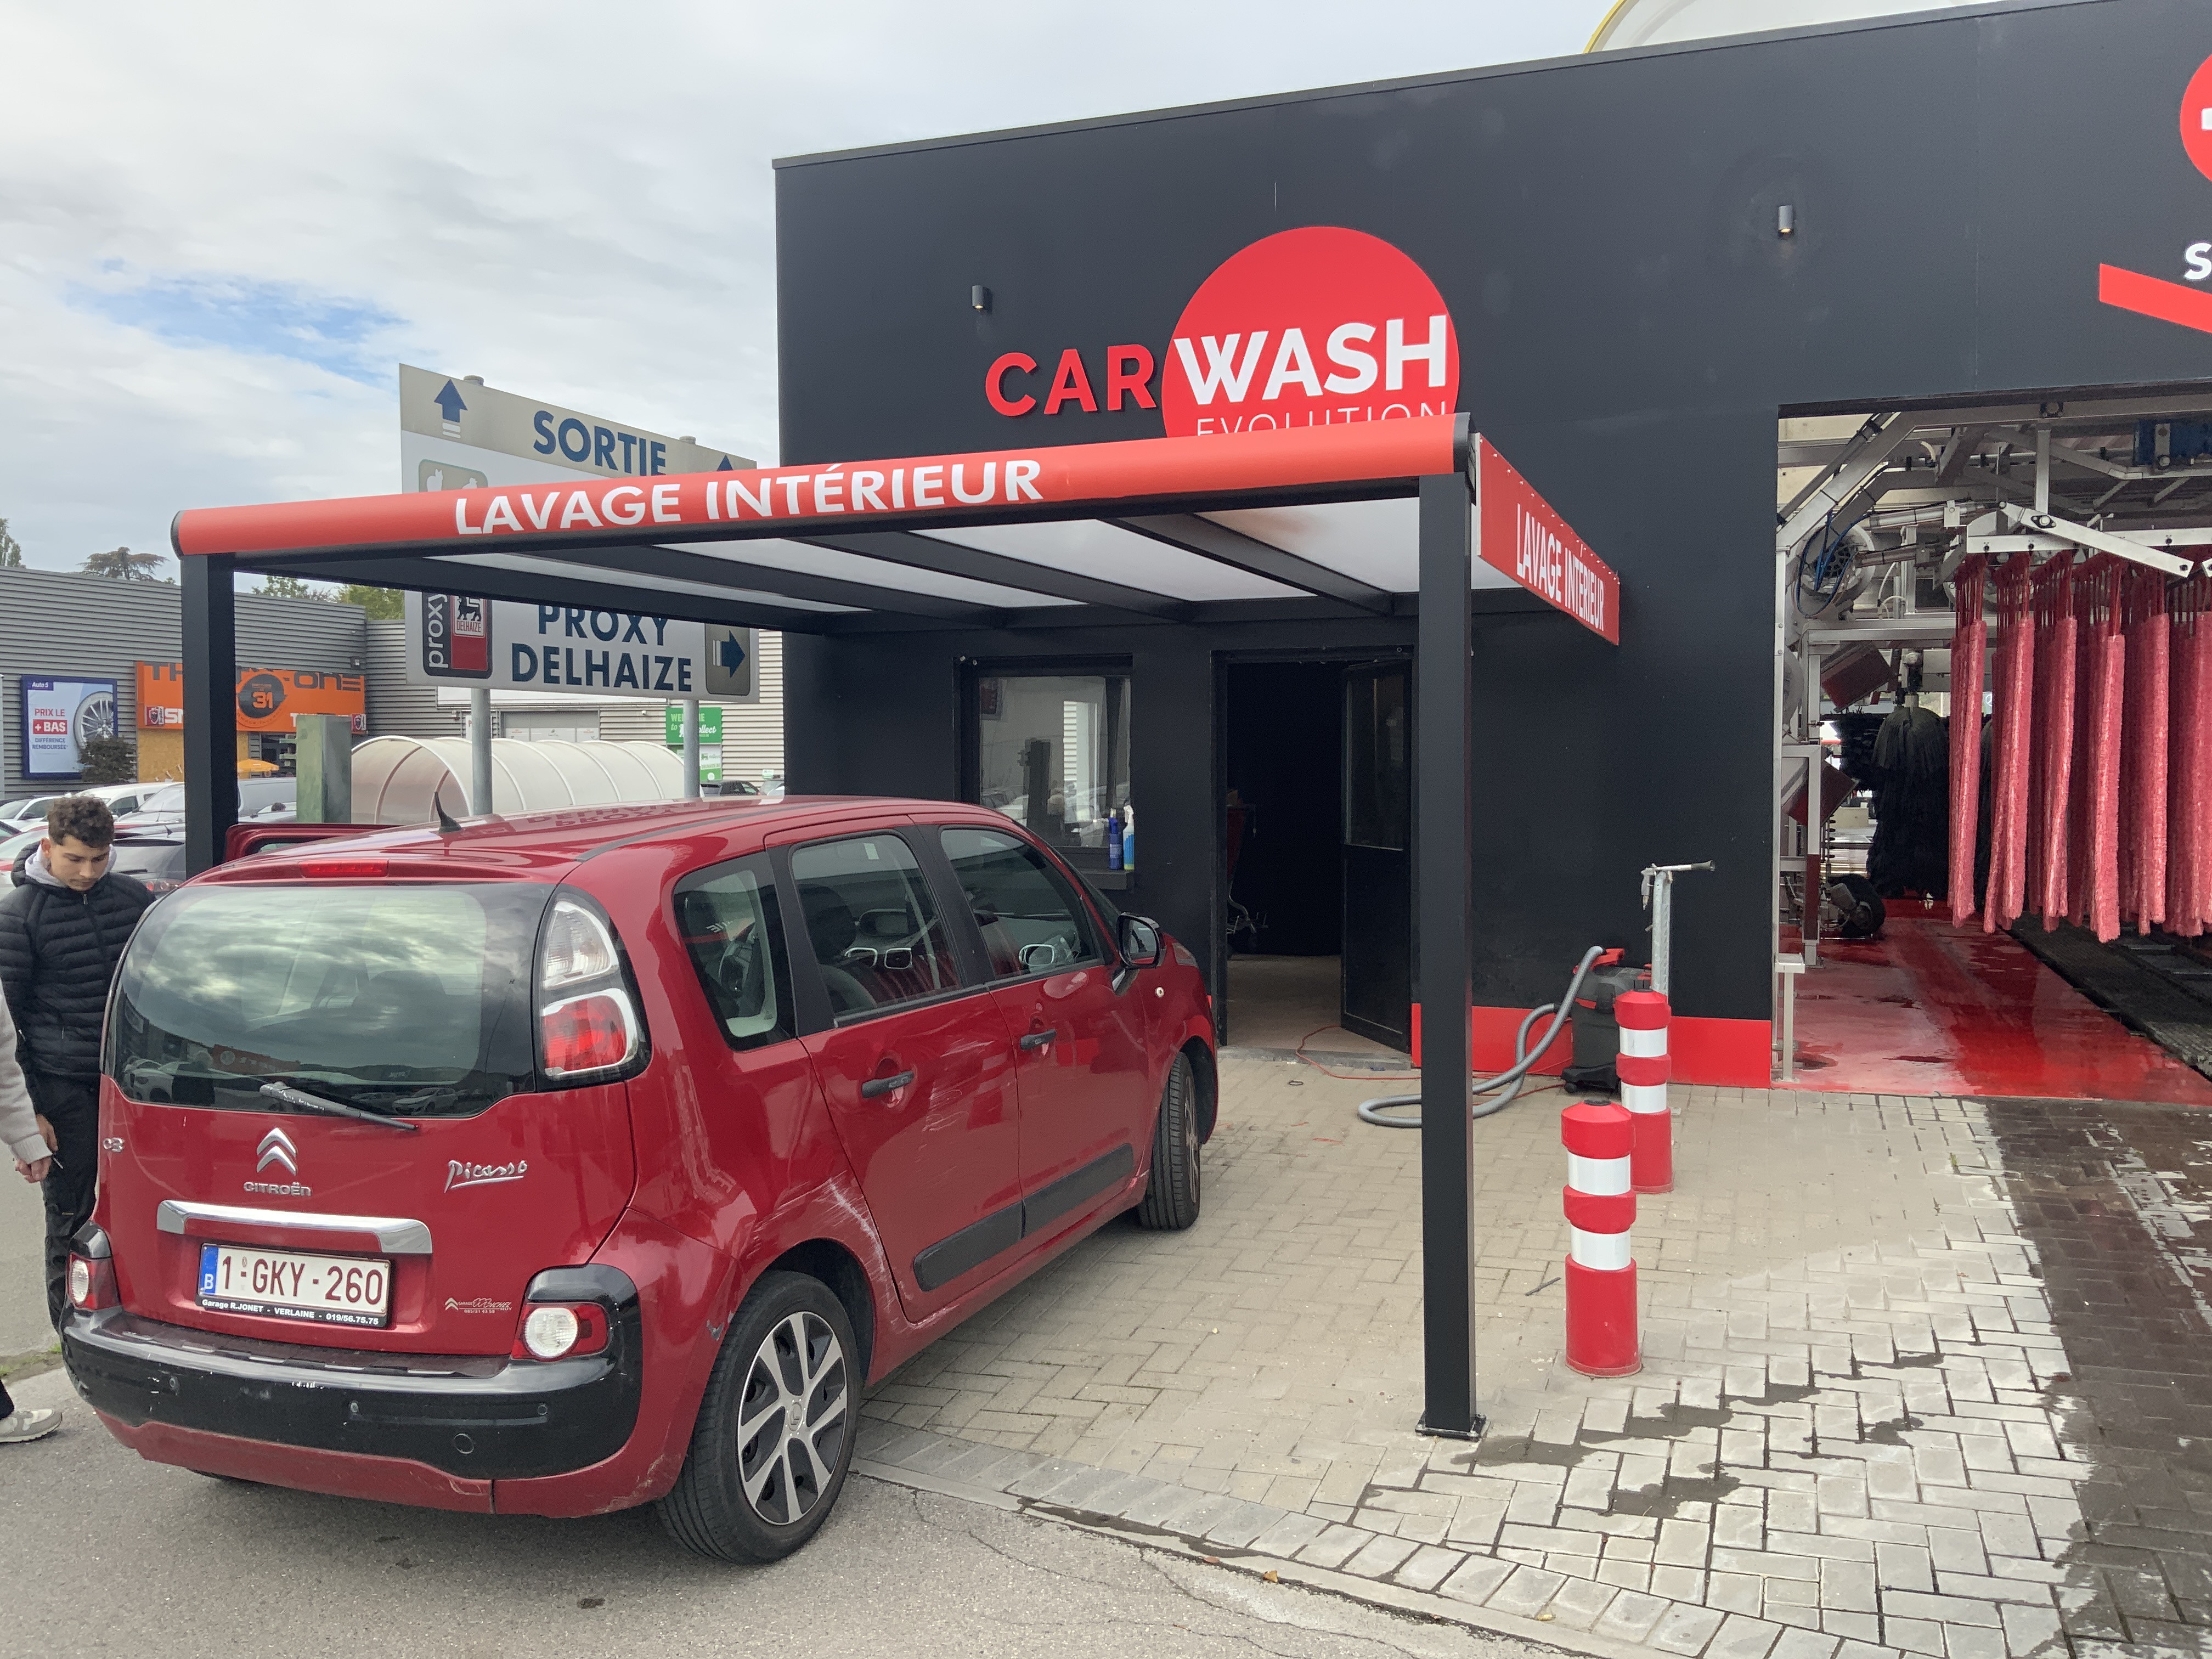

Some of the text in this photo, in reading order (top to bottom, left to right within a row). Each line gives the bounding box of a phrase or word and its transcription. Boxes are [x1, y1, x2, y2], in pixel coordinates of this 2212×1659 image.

[985, 314, 1447, 417] CAR WASH
[532, 410, 667, 477] SORTIE
[455, 459, 1044, 535] LAVAGE INTÉRIEUR
[1516, 503, 1562, 603] LAVAGE
[428, 593, 449, 668] proxy
[456, 620, 482, 633] DELHAIZE
[538, 605, 668, 646] PROXY
[511, 643, 692, 692] DELHAIZE
[35, 708, 65, 717] PRIX LE
[252, 691, 273, 709] 31
[43, 721, 66, 732] BAS
[670, 723, 717, 734] to ollect
[103, 1137, 125, 1153] C3
[444, 1160, 528, 1193] Picasso
[204, 1256, 383, 1305] B 1-GKY-260
[202, 1299, 229, 1309] Garage
[230, 1302, 264, 1312] R.JONET
[274, 1307, 314, 1318] VERLAINE
[326, 1313, 379, 1325] 019/56.75.75
[472, 1297, 512, 1308] MICHEL
